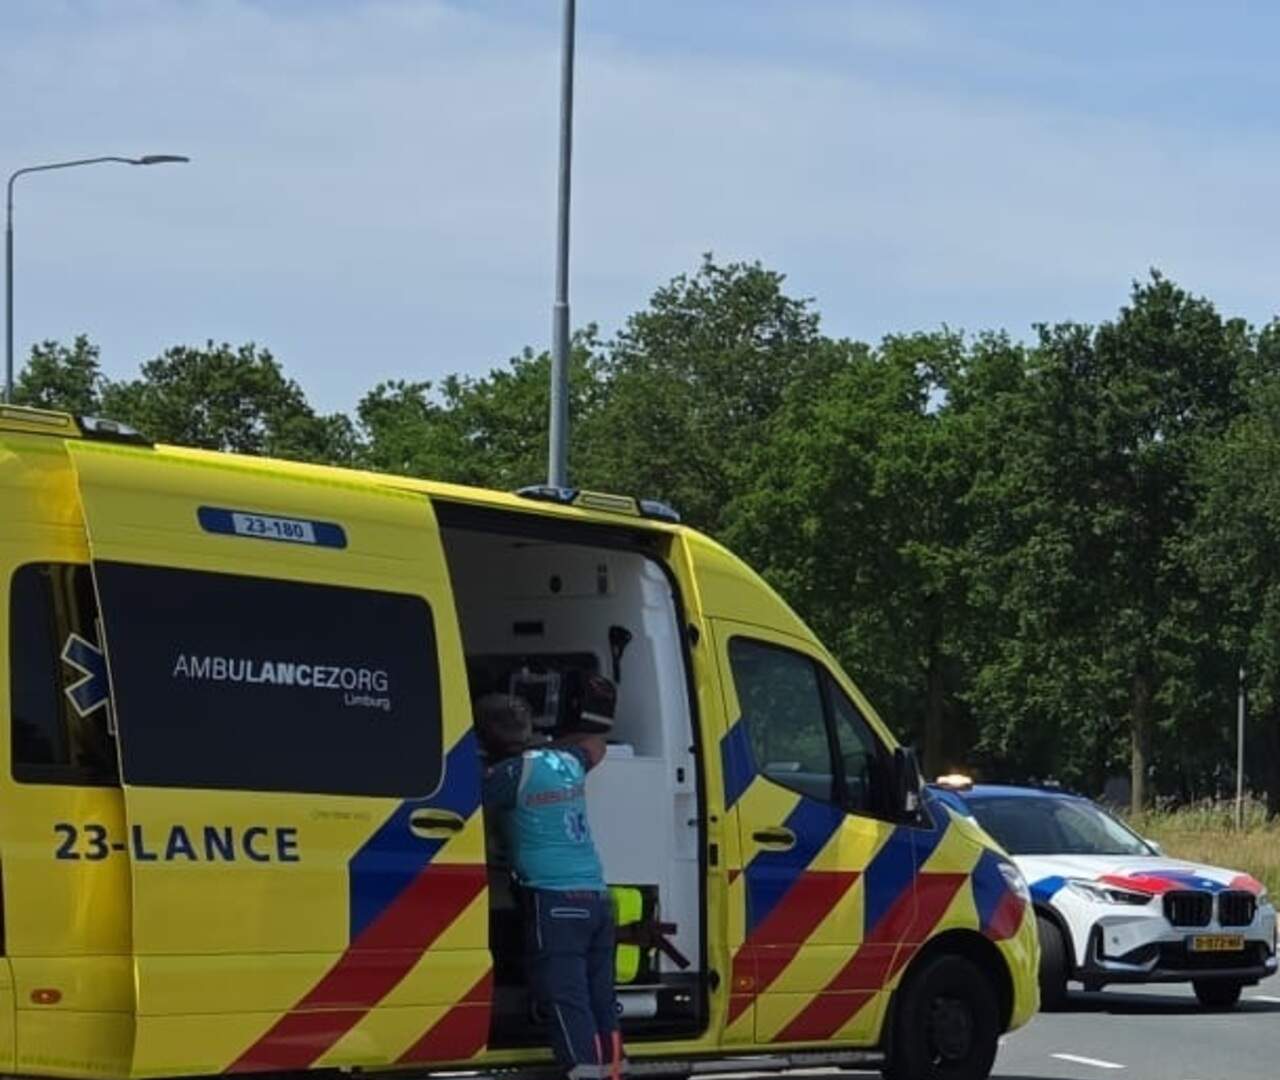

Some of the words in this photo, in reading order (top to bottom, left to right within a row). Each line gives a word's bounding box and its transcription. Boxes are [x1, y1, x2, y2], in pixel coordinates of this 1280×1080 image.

[244, 516, 305, 538] 23-180
[173, 654, 389, 692] AMBULANCEZORG
[54, 823, 301, 863] 23-LANCE
